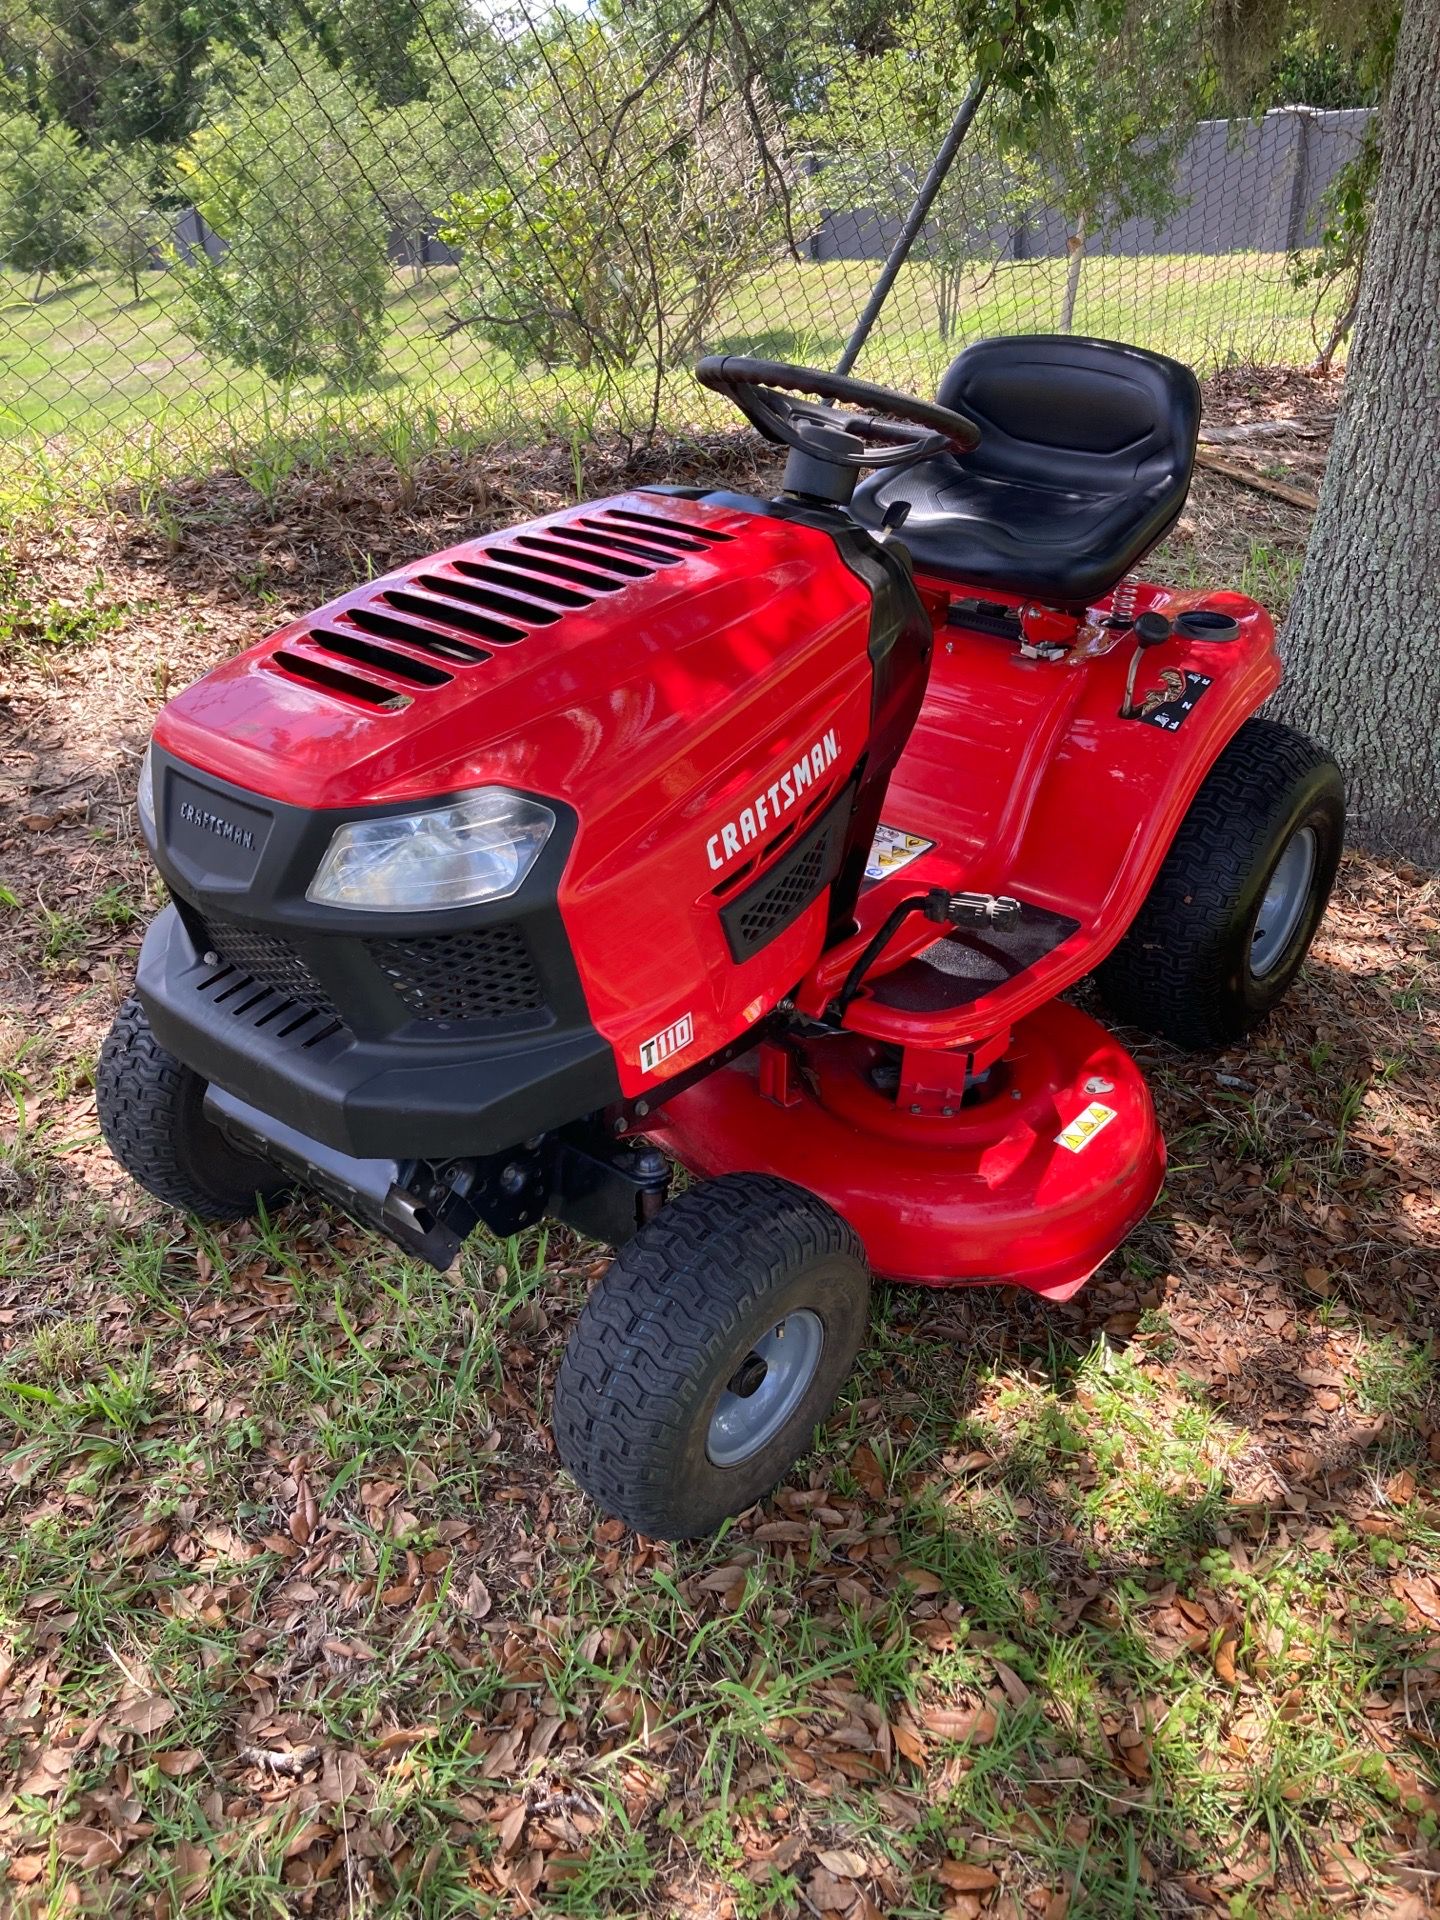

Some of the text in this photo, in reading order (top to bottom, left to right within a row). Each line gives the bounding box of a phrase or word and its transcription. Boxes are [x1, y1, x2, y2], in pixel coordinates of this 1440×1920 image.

[1168, 721, 1180, 730] F
[1181, 701, 1192, 710] N
[706, 728, 838, 871] CRAFTSMAN
[180, 802, 254, 850] CRAFTSMAN
[641, 1018, 691, 1068] T110
